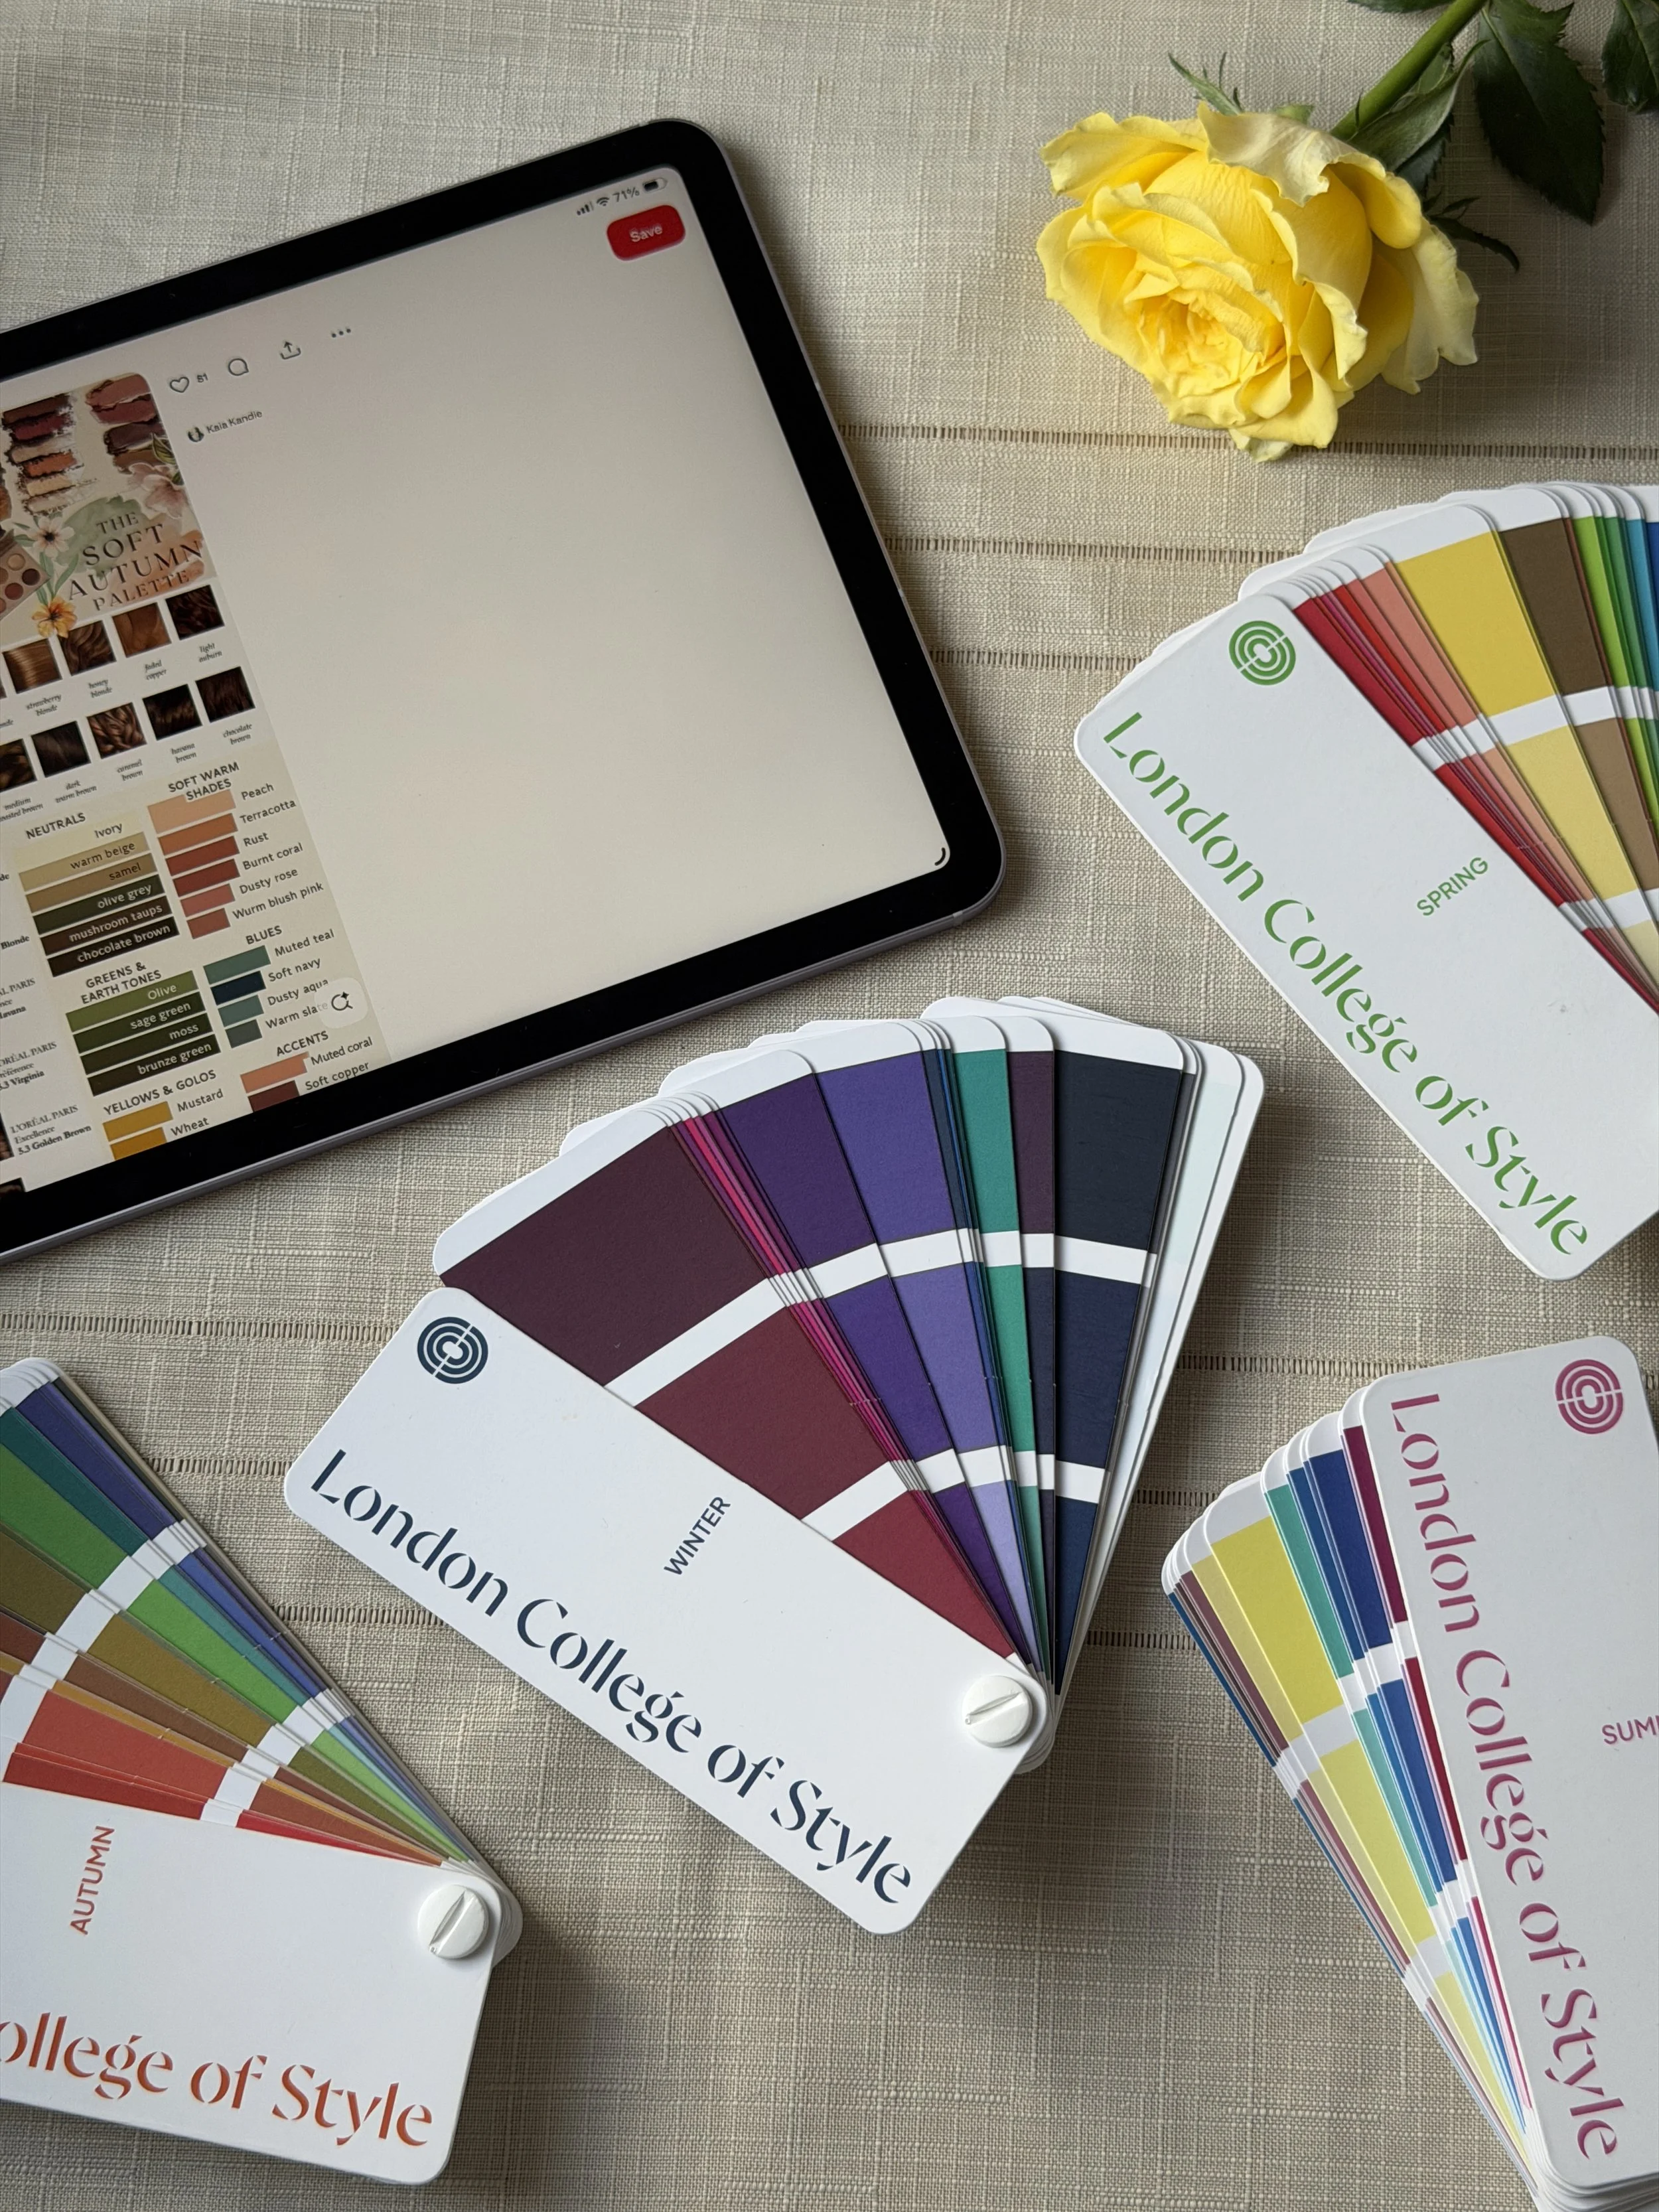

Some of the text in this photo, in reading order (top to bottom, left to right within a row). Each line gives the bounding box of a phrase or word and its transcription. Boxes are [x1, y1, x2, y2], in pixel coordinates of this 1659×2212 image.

[612, 186, 640, 202] 71%
[630, 224, 663, 243] Save
[228, 410, 263, 426] Kandie
[96, 512, 139, 534] THE
[82, 523, 163, 566] SOFT
[68, 540, 202, 601] AUTUMN
[93, 569, 190, 611] PALETTE
[168, 762, 240, 793] SOFT WARM
[186, 778, 232, 801] SHADES
[241, 782, 275, 801] Peach
[240, 799, 297, 824] Terracotta
[25, 812, 87, 840] NEUTRALS
[94, 822, 124, 840] Ivory
[243, 832, 269, 848] Rust
[70, 841, 137, 871] warm beige
[242, 842, 304, 871] Burnt coral
[109, 862, 143, 881] samel
[240, 869, 299, 895] Dusty rose
[98, 883, 153, 910] olive grey
[268, 891, 298, 909] blush
[299, 881, 325, 901] pink
[1415, 856, 1489, 917] SPRING
[69, 903, 164, 944] mushroom taups
[245, 925, 283, 946] BLUES
[1, 935, 30, 950] Blonde
[76, 924, 171, 964] chocolate brown
[274, 928, 335, 958] Muted teal
[85, 961, 147, 990] GREENS &
[268, 958, 322, 983] Soft navy
[1104, 711, 1589, 1256] London College of Style
[9, 978, 36, 993] PARIS
[80, 970, 162, 1005] EARTH TONES
[147, 983, 178, 1001] Olive
[267, 978, 329, 1007] Dusty aqua
[130, 1001, 192, 1031] sage green
[265, 1011, 301, 1030] Warm
[169, 1024, 200, 1041] moss
[276, 1031, 330, 1057] ACCENTS
[31, 1041, 58, 1057] PARIS
[137, 1043, 212, 1075] brunze green
[310, 1036, 374, 1066] Muted coral
[9, 1070, 45, 1085] Virginia
[305, 1062, 370, 1091] Soft copper
[51, 1104, 78, 1120] PARIS
[103, 1085, 161, 1116] YELLOWS
[162, 1084, 174, 1096] &
[177, 1088, 224, 1113] Mustard
[15, 1126, 55, 1144] Excellence
[32, 1134, 63, 1151] Golden
[63, 1125, 92, 1140] Brown
[171, 1116, 210, 1137] Wheat
[664, 1496, 731, 1576] WINTER
[311, 1448, 911, 1903] London College of Style
[1601, 1715, 1659, 1745] SUM
[1390, 1393, 1626, 2160] London College of Style
[70, 1825, 115, 1936] AUTUMN
[190, 2054, 268, 2109] of
[271, 2064, 433, 2147] Style
